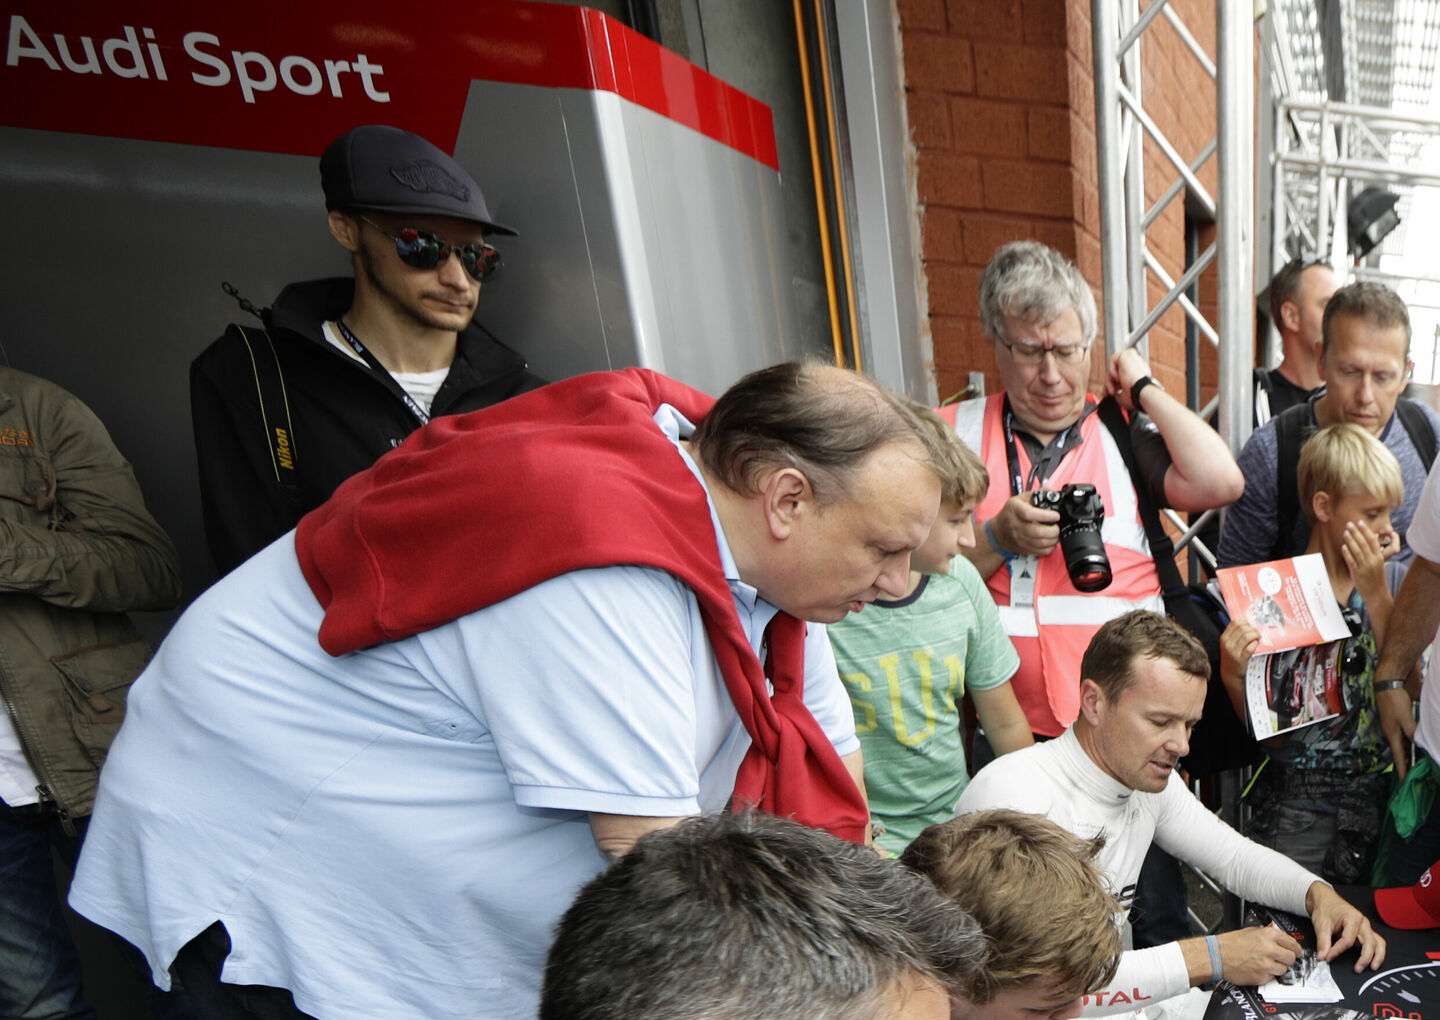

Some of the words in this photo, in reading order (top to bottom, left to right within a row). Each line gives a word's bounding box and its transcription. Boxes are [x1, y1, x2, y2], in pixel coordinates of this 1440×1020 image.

[6, 15, 168, 81] Audi
[183, 32, 391, 103] Sport
[276, 427, 293, 470] Nikon
[1081, 987, 1151, 1007] TAL
